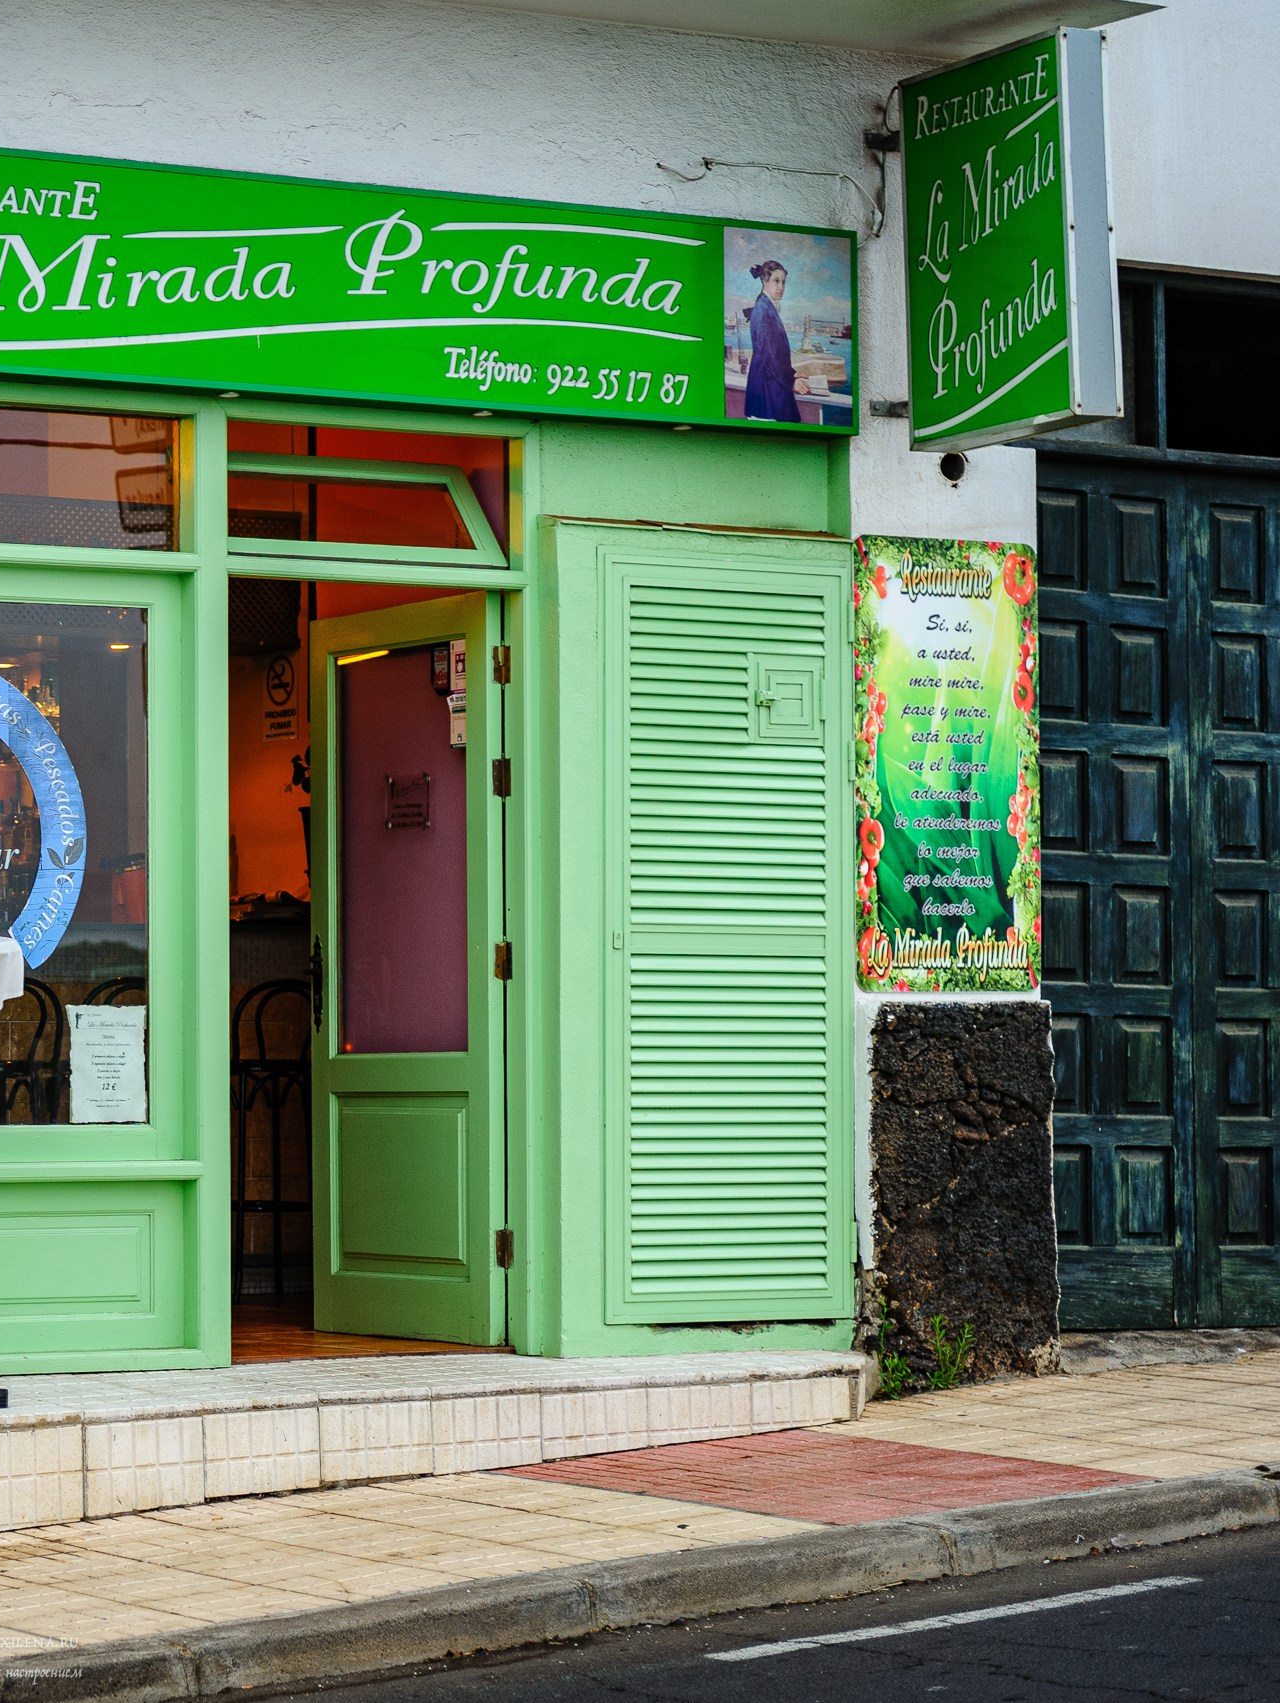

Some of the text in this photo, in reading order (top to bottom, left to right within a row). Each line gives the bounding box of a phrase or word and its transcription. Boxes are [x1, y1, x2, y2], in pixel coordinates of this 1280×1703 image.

[914, 52, 1049, 140] RESTAURANTE
[918, 130, 1056, 284] La Mirada
[344, 208, 686, 315] Profunda
[928, 257, 1058, 400] Profunda
[443, 344, 689, 405] Teléfono: 922 55 17 87
[900, 547, 993, 603] Restaurante
[917, 645, 976, 662] a usted,
[909, 675, 984, 691] mire mire,
[900, 702, 992, 720] pase y mire,
[911, 729, 985, 745] está usted
[908, 757, 988, 779] en el lugar
[33, 738, 80, 848] Pescados
[910, 785, 985, 803] adecuado,
[894, 812, 1002, 831] le atenderemos
[917, 841, 981, 864] lo mejor
[902, 868, 993, 893] que sabemos
[23, 874, 75, 949] Carnes
[921, 897, 976, 916] hacerlo
[867, 922, 1029, 982] La Mirada Profunda
[102, 1082, 110, 1091] 12
